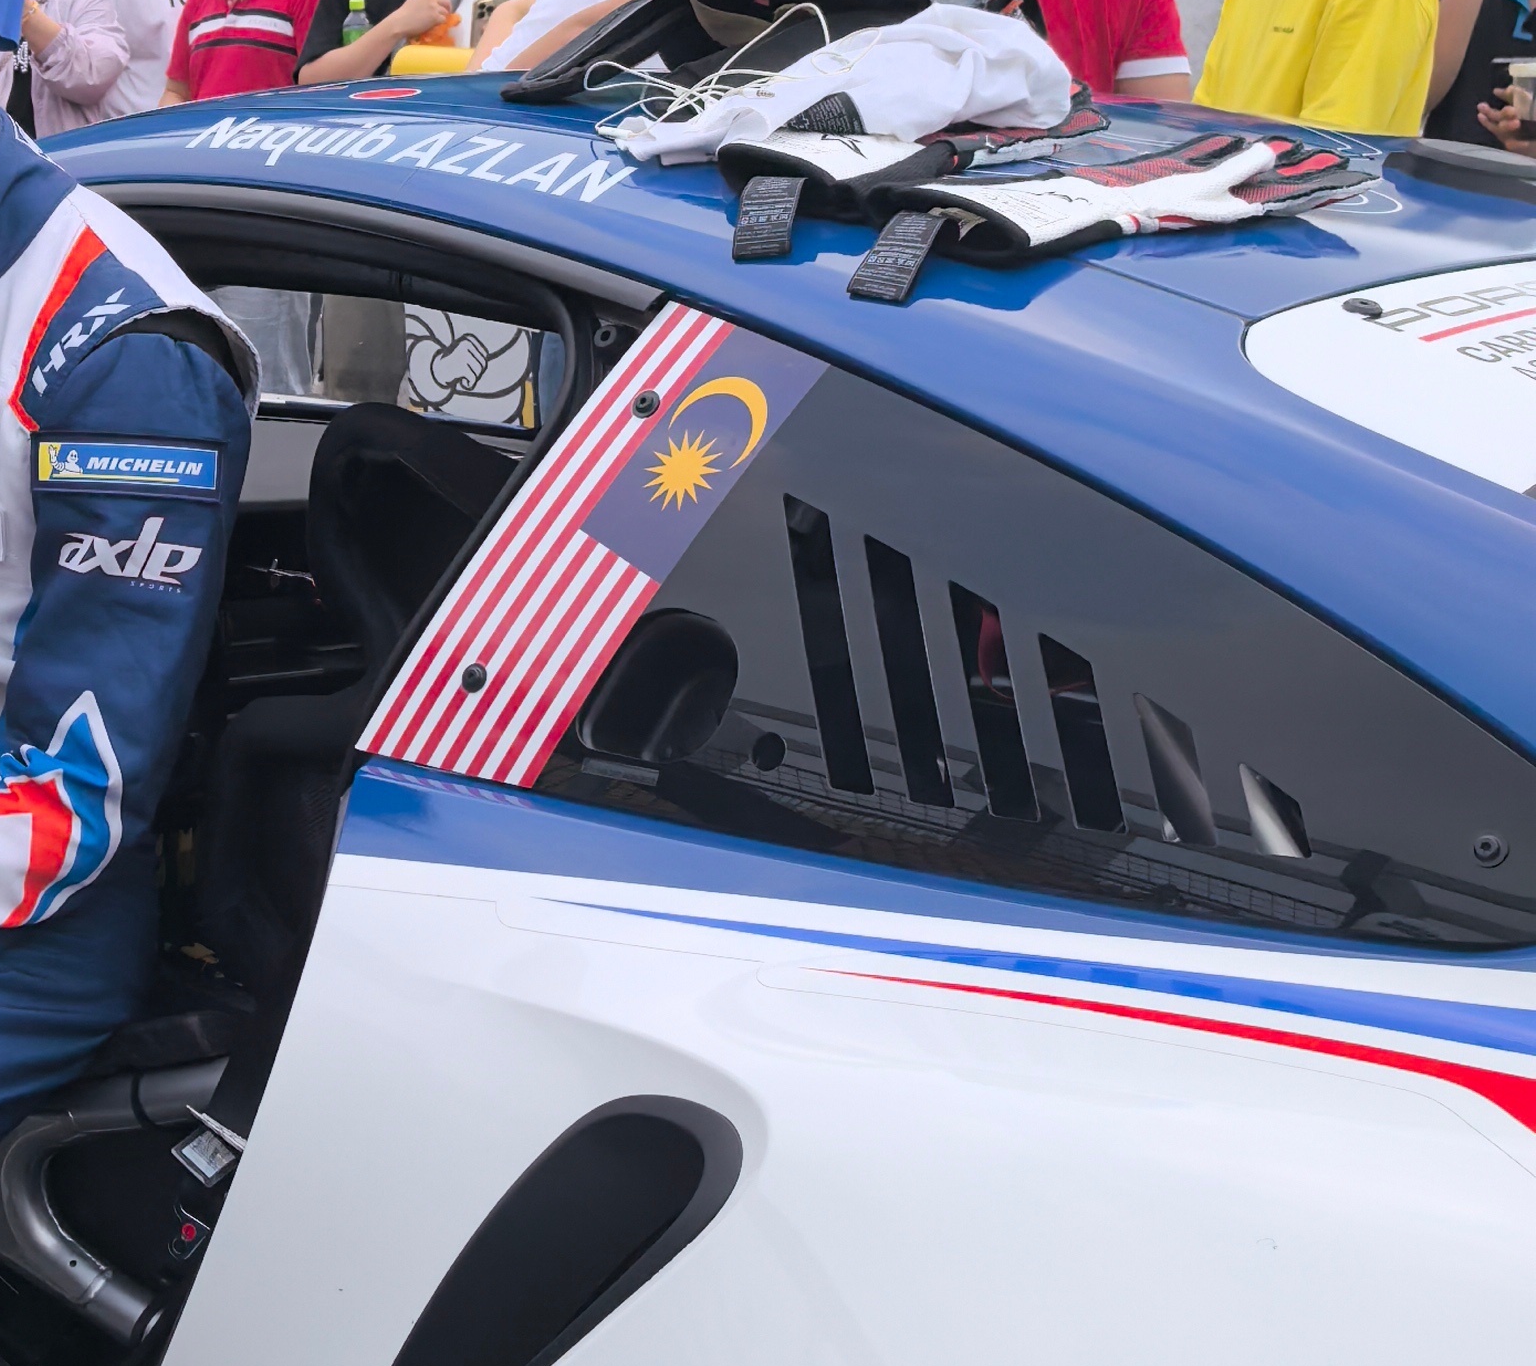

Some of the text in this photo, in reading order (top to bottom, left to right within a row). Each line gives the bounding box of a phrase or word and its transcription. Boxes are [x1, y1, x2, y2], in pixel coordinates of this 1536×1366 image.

[185, 116, 639, 203] Naquib AZLAN
[31, 287, 132, 398] HRX
[85, 456, 204, 477] MICHELIN
[57, 516, 203, 586] axle
